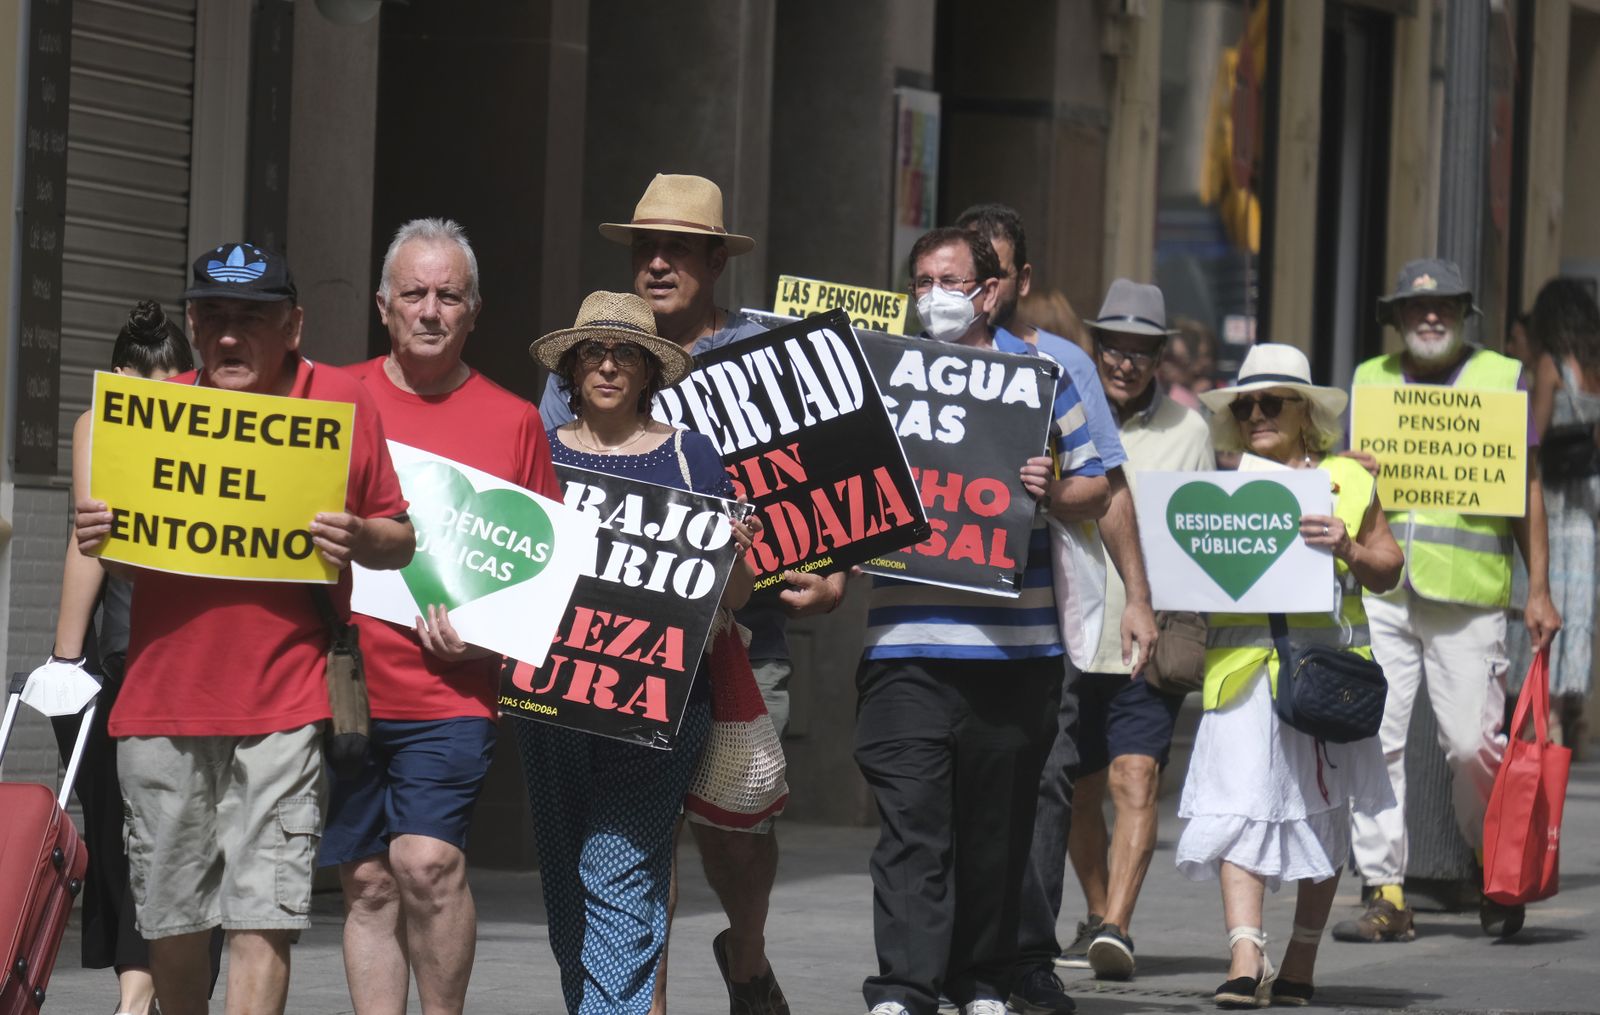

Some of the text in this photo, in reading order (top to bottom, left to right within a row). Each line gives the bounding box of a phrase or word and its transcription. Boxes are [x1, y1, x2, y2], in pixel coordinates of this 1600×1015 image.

[782, 281, 900, 319] LAS PENSIONES
[651, 328, 864, 456] BERTAD
[889, 350, 1041, 409] AGUA
[1393, 390, 1482, 408] NINGUNA
[102, 391, 342, 450] ENVEJECER
[1398, 414, 1480, 433] PENSIÓN
[1360, 438, 1517, 460] POR DEBAJO DEL
[152, 457, 266, 502] EN EL
[1377, 463, 1506, 484] MBRAL DE LA
[1393, 488, 1480, 506] POBREZA
[110, 507, 316, 560] ENTORNO
[744, 466, 914, 577] RDAZA
[1174, 512, 1294, 531] RESIDENCIAS
[899, 517, 1016, 569] SAL
[1190, 533, 1278, 554] PÚBLICAS
[509, 654, 670, 722] URA
[518, 698, 558, 716] CÓRDOBA
